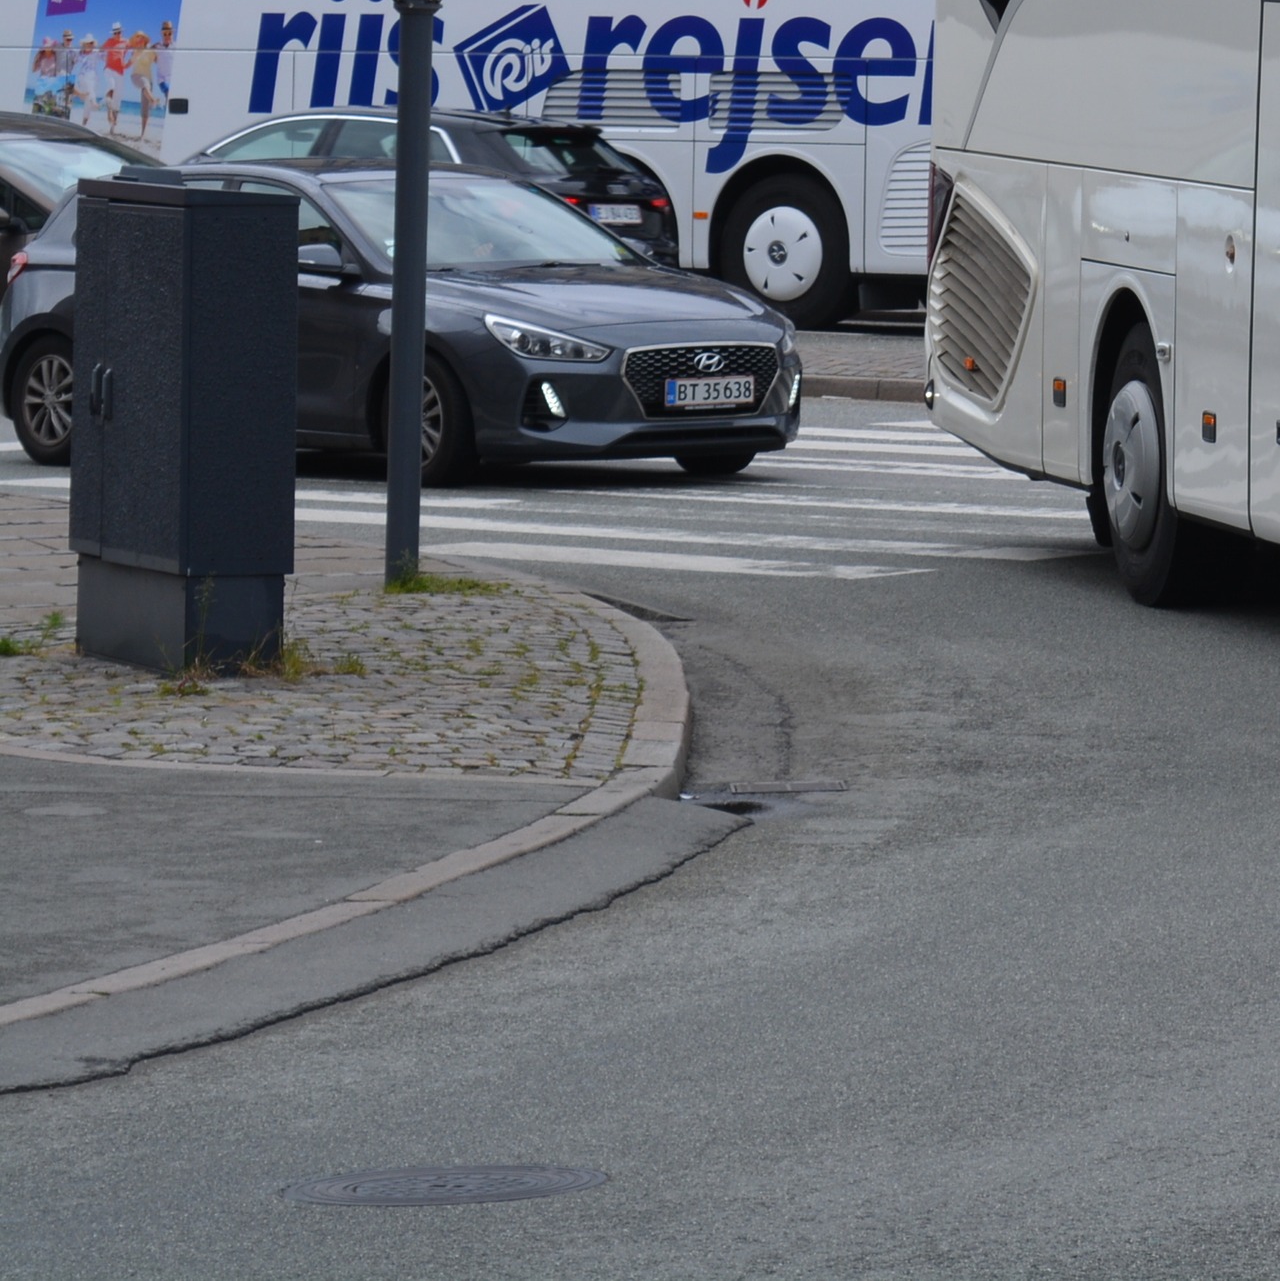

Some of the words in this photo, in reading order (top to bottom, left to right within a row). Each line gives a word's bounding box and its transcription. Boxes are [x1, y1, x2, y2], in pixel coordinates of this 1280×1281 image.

[678, 383, 699, 401] BT
[702, 383, 720, 400] 35
[723, 380, 752, 399] 638
